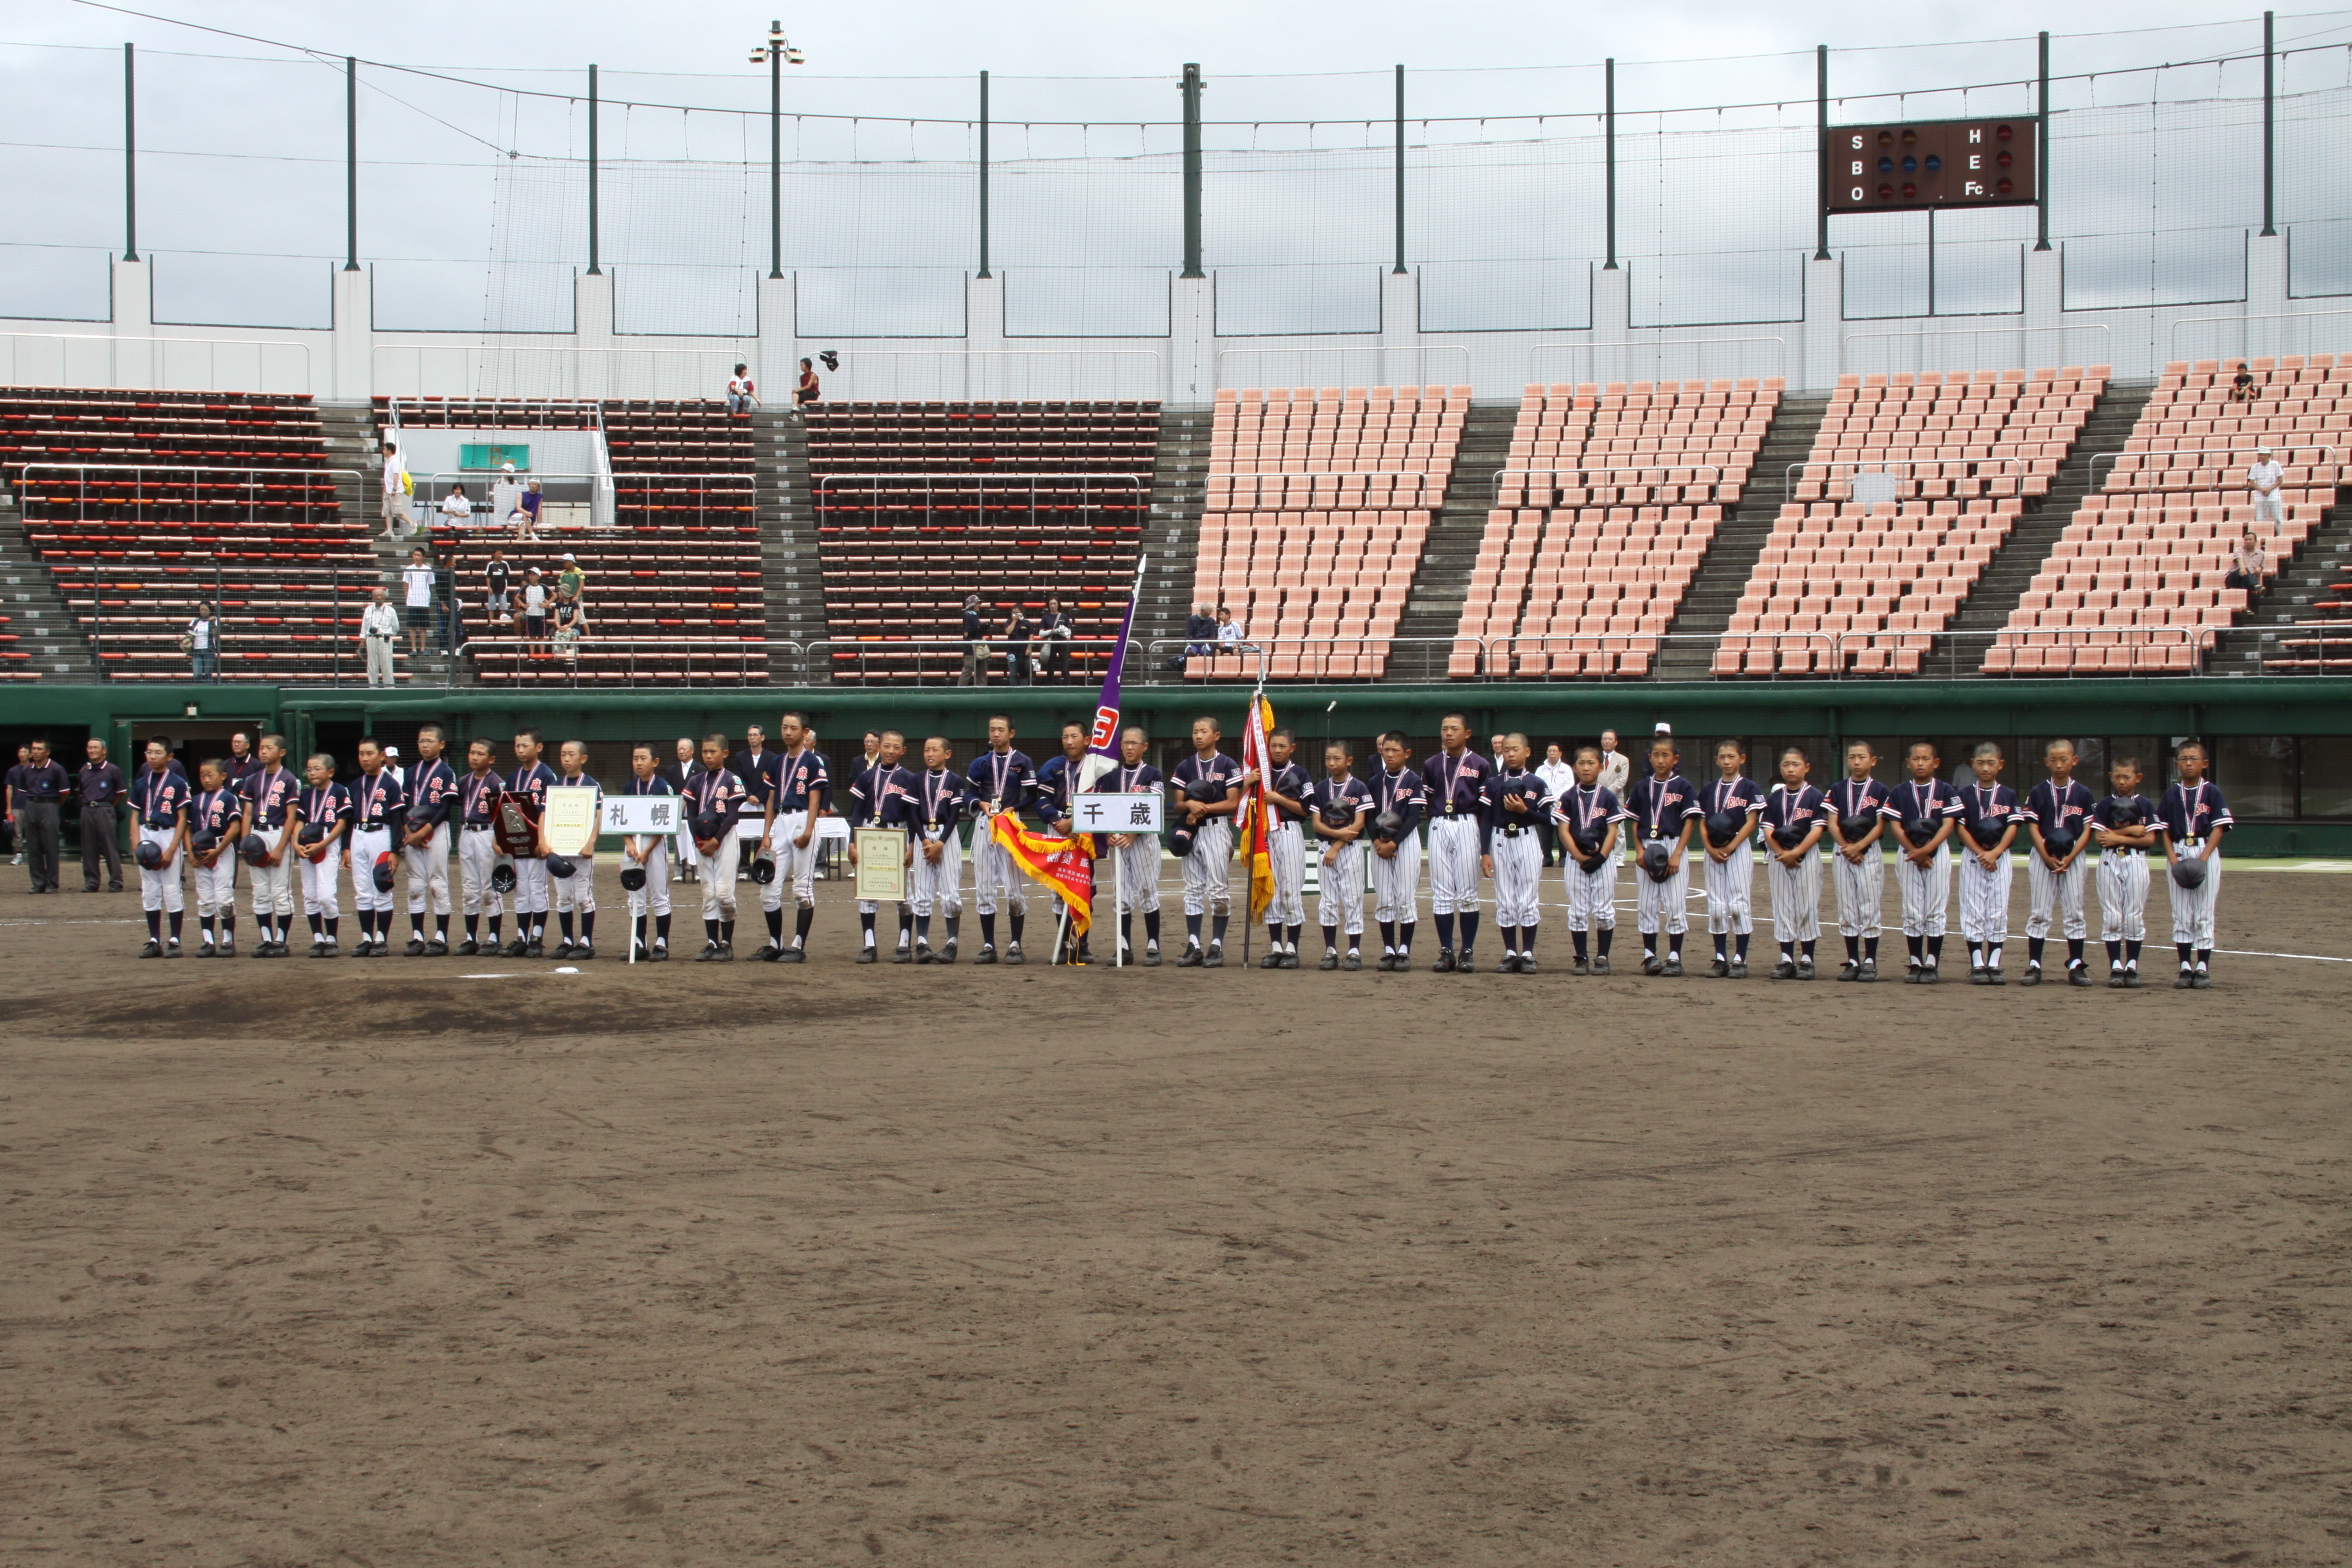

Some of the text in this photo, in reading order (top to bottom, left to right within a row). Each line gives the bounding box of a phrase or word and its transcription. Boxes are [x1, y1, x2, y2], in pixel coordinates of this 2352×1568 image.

[1852, 135, 1863, 150] S
[1969, 129, 1980, 144] H
[1851, 161, 1863, 175] B
[1969, 155, 1981, 170] E
[1851, 186, 1863, 201] O
[1965, 181, 1983, 196] Fc
[1727, 796, 1748, 809] EAST
[609, 804, 670, 826] 札幌
[1083, 802, 1152, 825] 千歳
[1793, 808, 1814, 821] EAST
[1990, 804, 2011, 817] EAST
